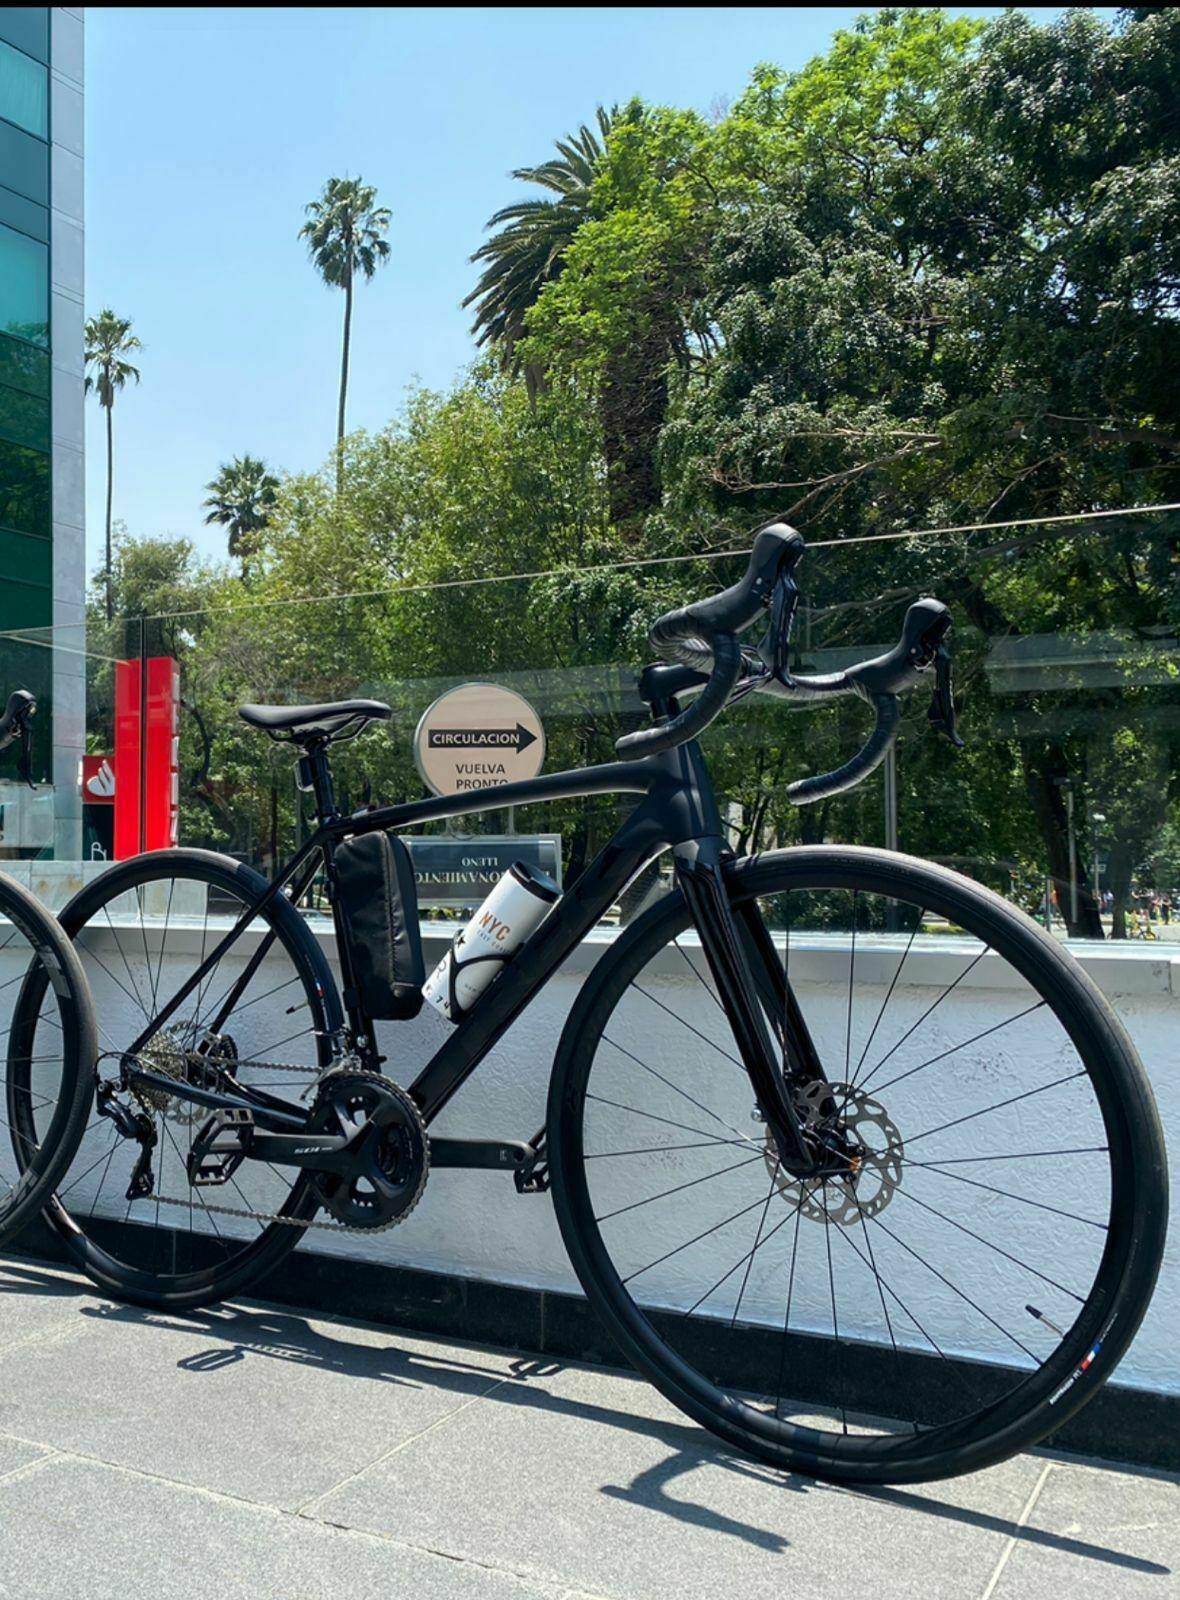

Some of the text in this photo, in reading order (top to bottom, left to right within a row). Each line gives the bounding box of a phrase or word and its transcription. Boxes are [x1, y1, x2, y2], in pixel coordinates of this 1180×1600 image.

[432, 733, 520, 744] CIRCULACION
[456, 764, 505, 774] VUELVA
[462, 857, 498, 867] LLENO
[479, 911, 510, 941] NYC
